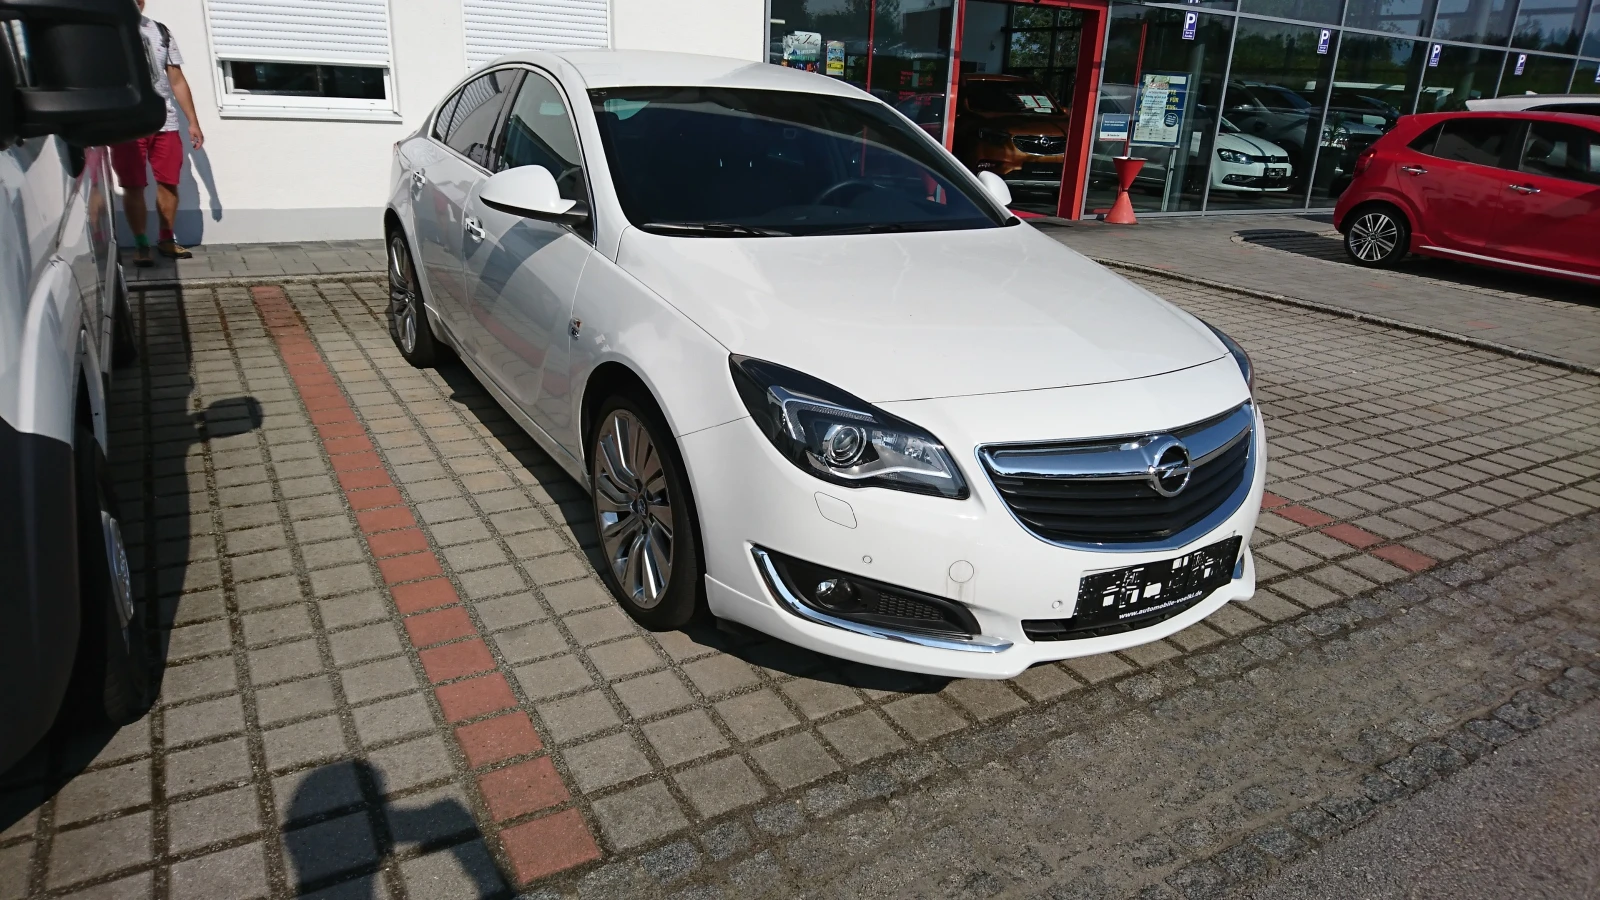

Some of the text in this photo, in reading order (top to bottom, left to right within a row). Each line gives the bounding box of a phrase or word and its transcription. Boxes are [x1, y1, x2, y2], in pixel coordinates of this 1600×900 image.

[1186, 13, 1196, 29] P
[1320, 30, 1329, 45] P
[1432, 44, 1441, 58] P
[1518, 54, 1526, 67] P
